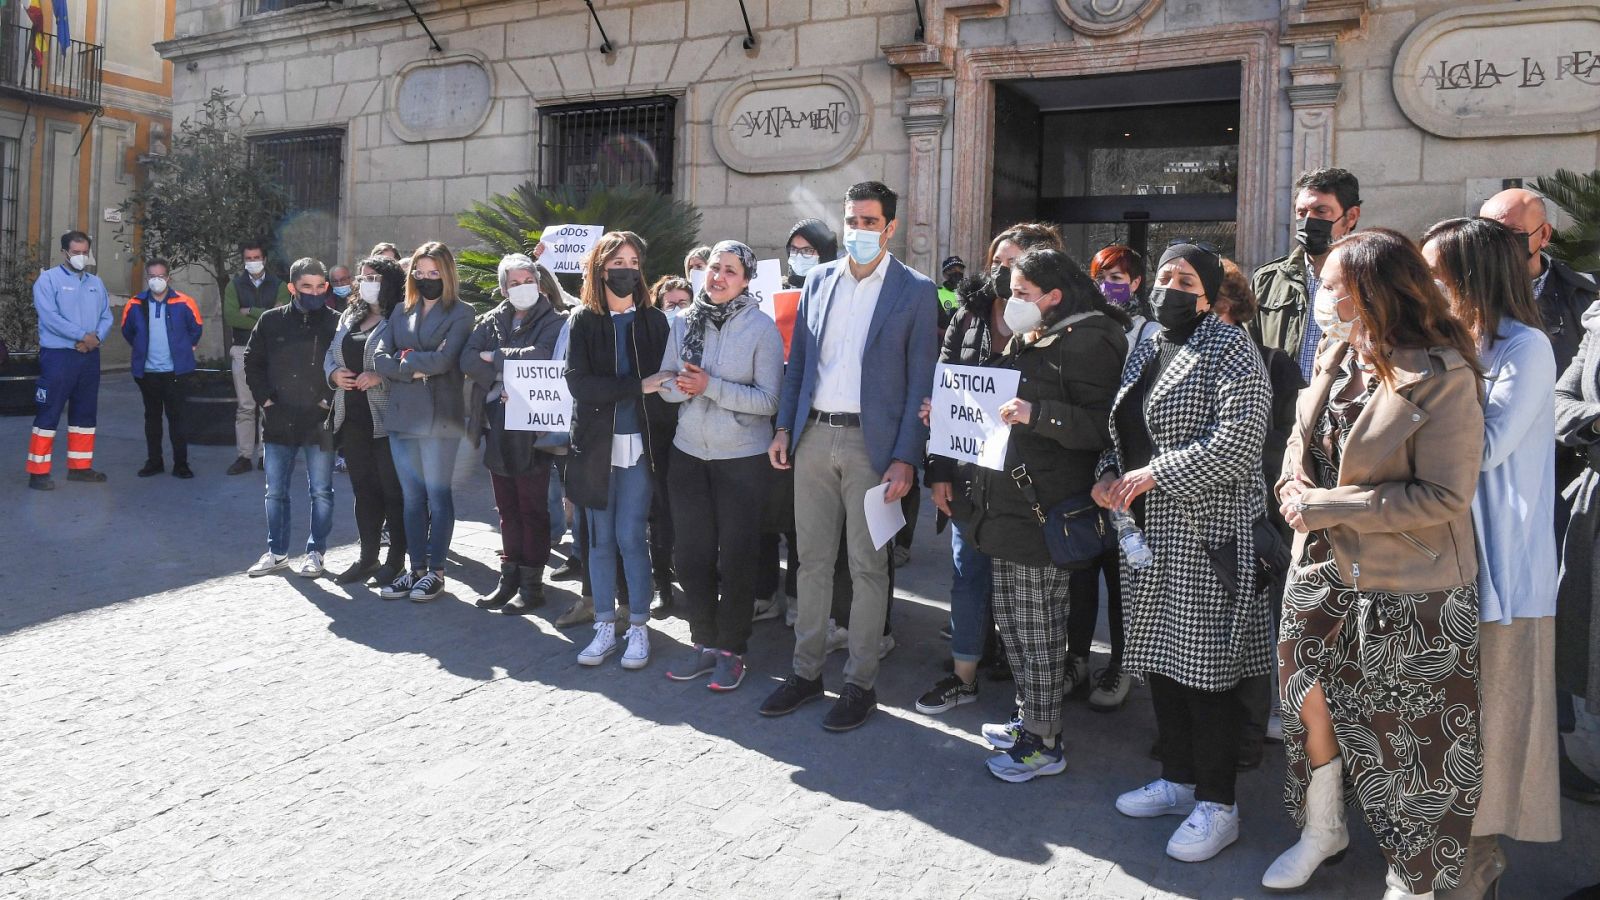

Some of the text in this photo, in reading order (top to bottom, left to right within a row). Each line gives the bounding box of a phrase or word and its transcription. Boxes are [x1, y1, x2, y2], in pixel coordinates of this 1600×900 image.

[1419, 59, 1517, 90] ALCALA
[1518, 57, 1546, 88] LA
[554, 244, 586, 253] SOMOS
[553, 261, 580, 271] JAULA
[940, 371, 996, 394] JUSTICIA
[529, 389, 562, 402] PARA
[527, 412, 565, 426] JAULA
[951, 404, 984, 424] PARA
[950, 434, 985, 457] JAULA
